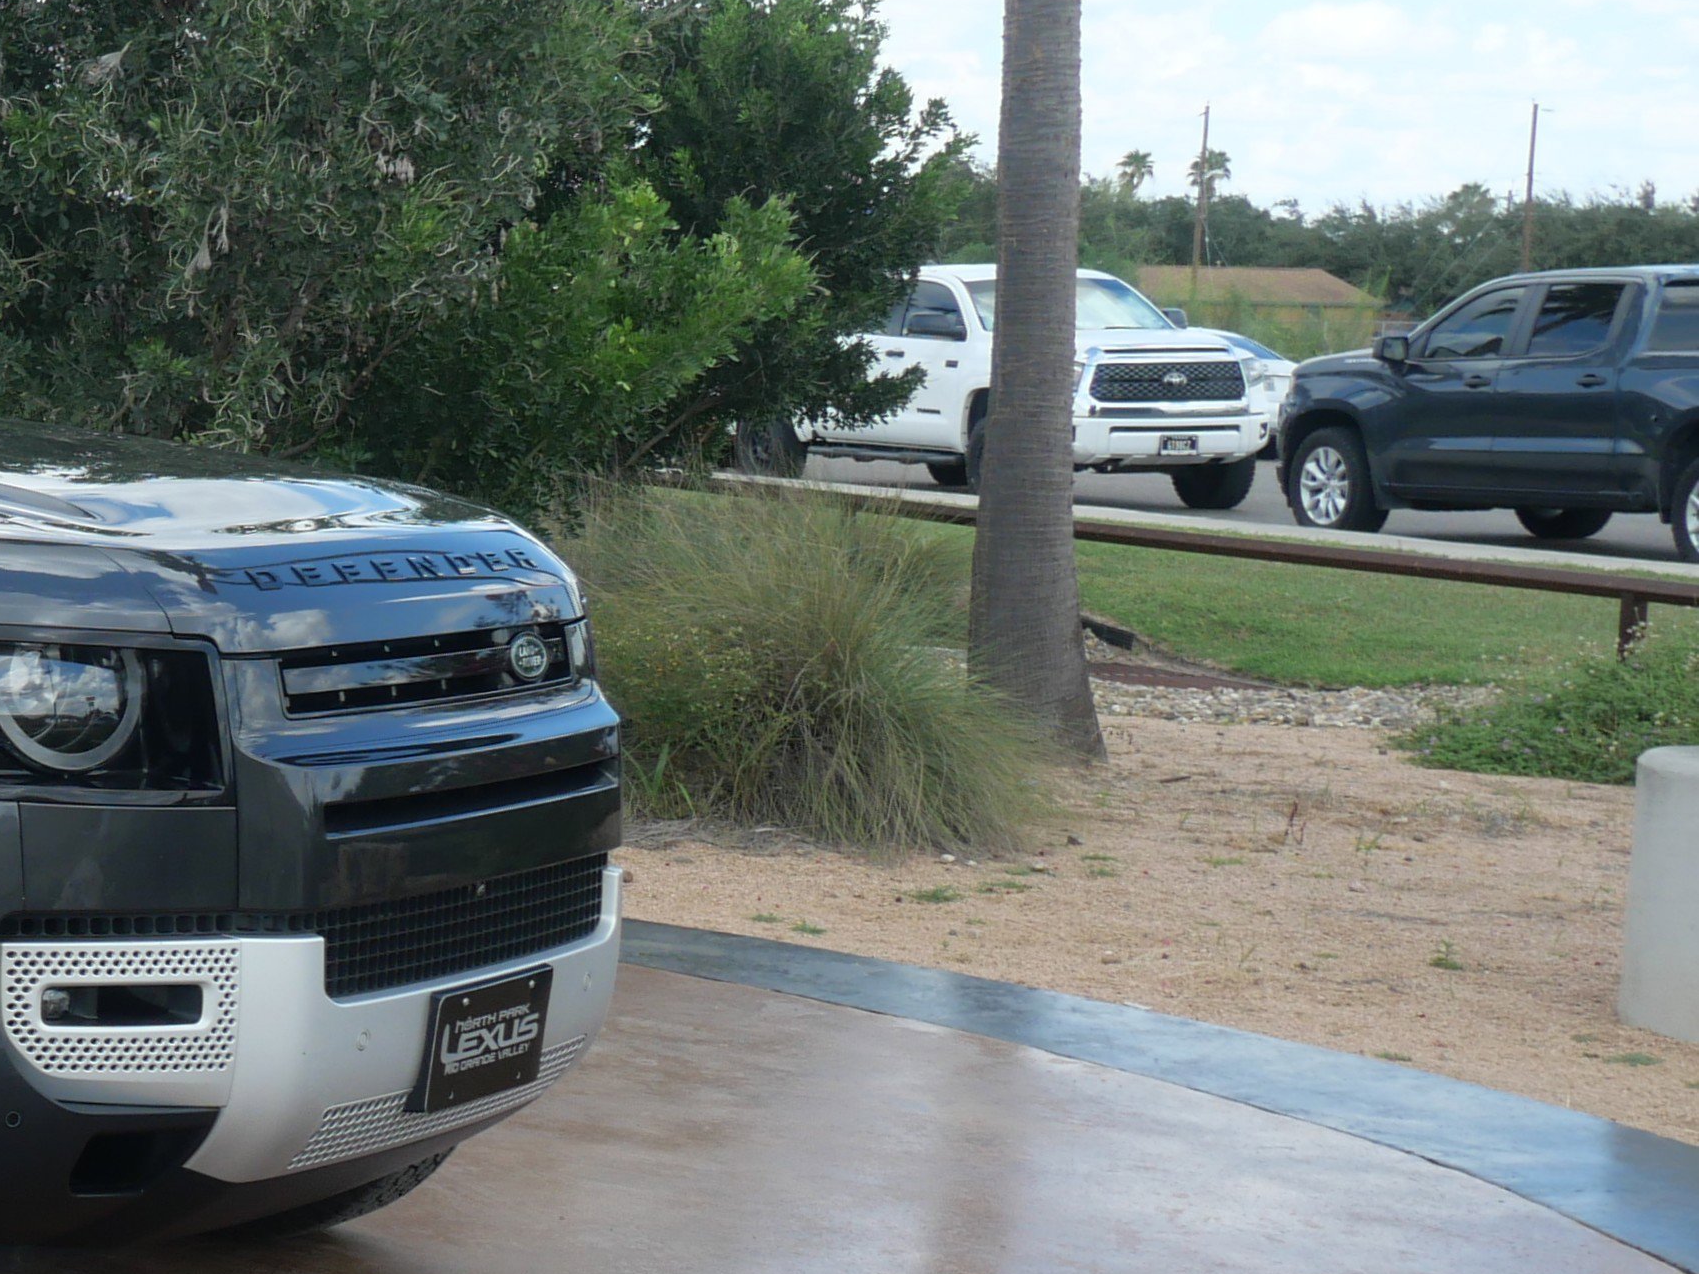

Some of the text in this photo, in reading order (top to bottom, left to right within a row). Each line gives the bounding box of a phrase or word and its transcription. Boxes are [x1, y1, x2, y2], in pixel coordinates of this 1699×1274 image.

[245, 548, 537, 591] DEFENDER
[498, 1004, 530, 1021] PARK
[441, 1012, 539, 1064] LEXUS
[460, 1054, 496, 1071] GRANDE
[498, 1043, 530, 1060] VALLEY
